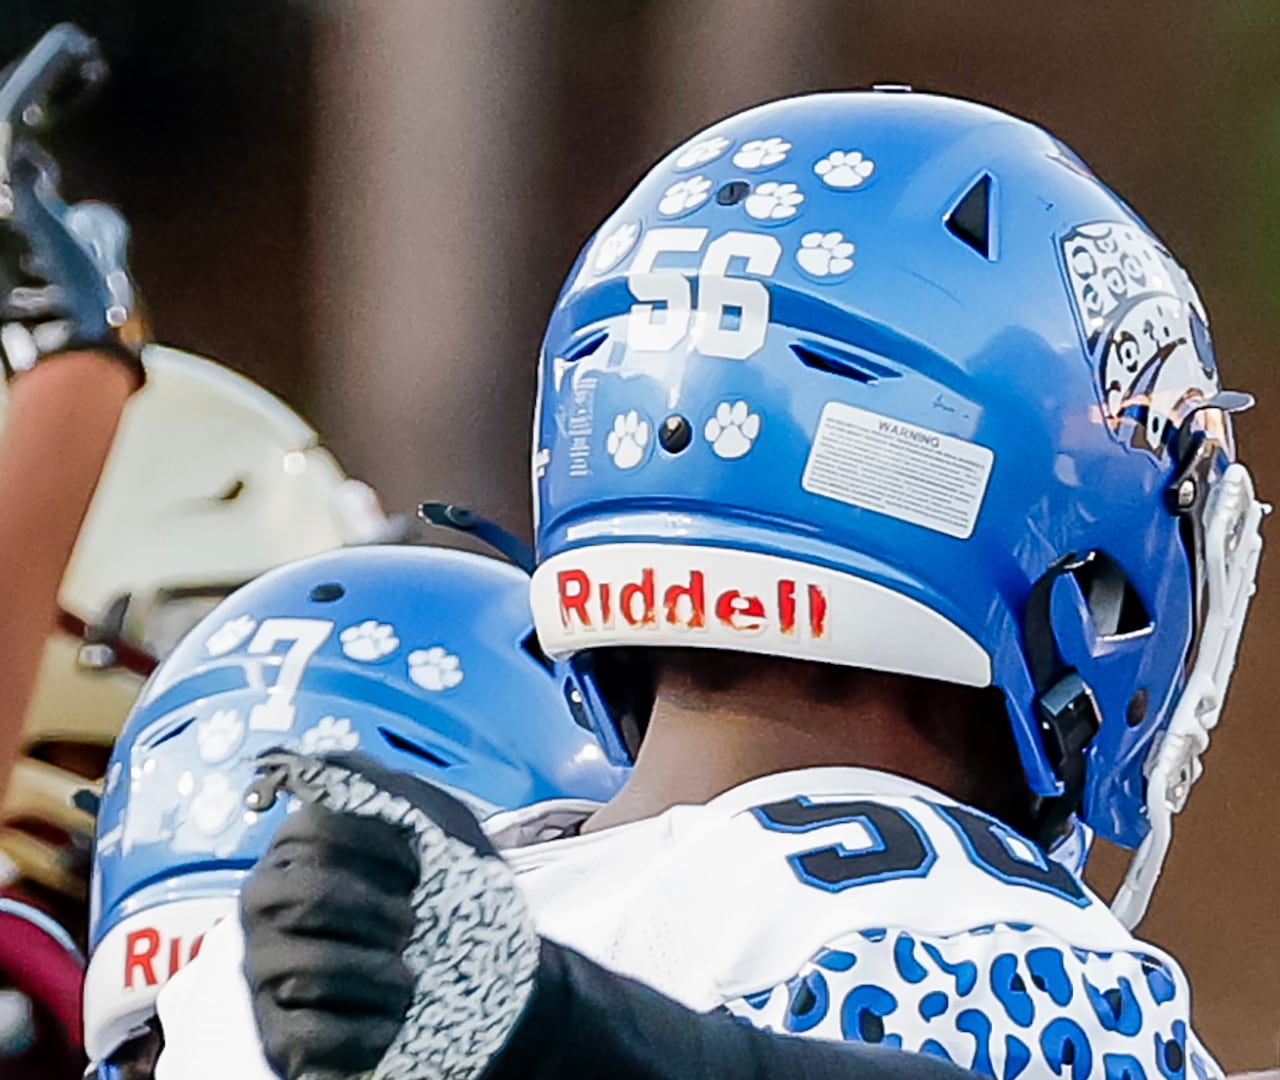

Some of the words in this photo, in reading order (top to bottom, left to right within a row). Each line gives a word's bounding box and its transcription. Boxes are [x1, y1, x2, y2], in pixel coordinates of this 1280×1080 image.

[627, 227, 783, 361] 56
[877, 418, 942, 449] WARNING
[556, 566, 828, 640] Riddell
[247, 618, 334, 732] 7
